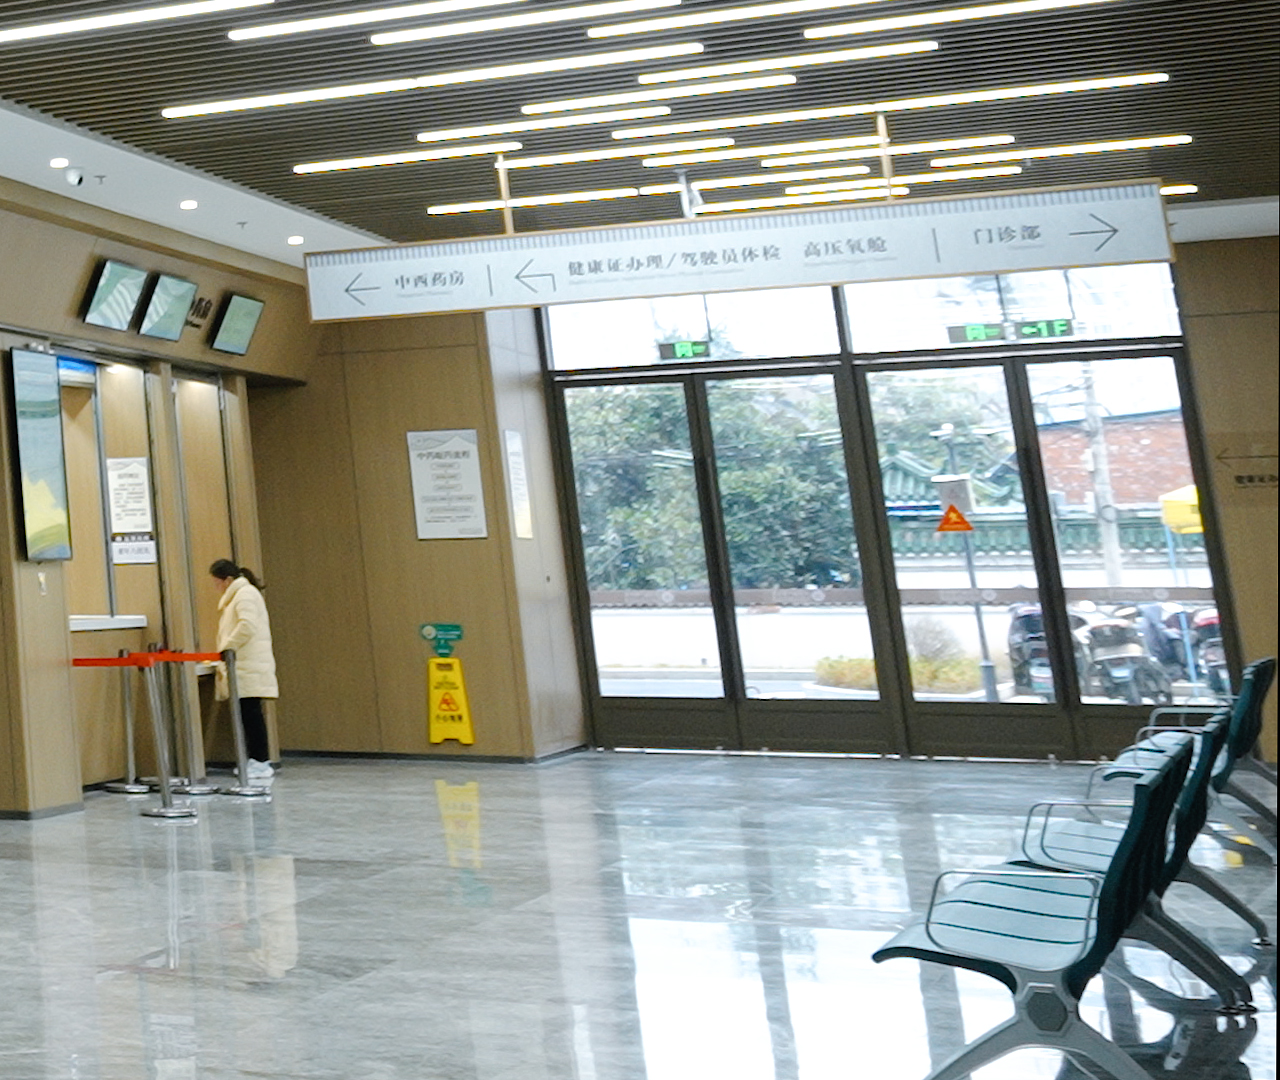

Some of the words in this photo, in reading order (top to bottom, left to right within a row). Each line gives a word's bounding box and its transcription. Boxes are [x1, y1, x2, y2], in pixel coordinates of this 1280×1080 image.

[974, 224, 1041, 245] 门诊部
[804, 237, 888, 258] 高压氧舱
[395, 270, 464, 290] 中西药房
